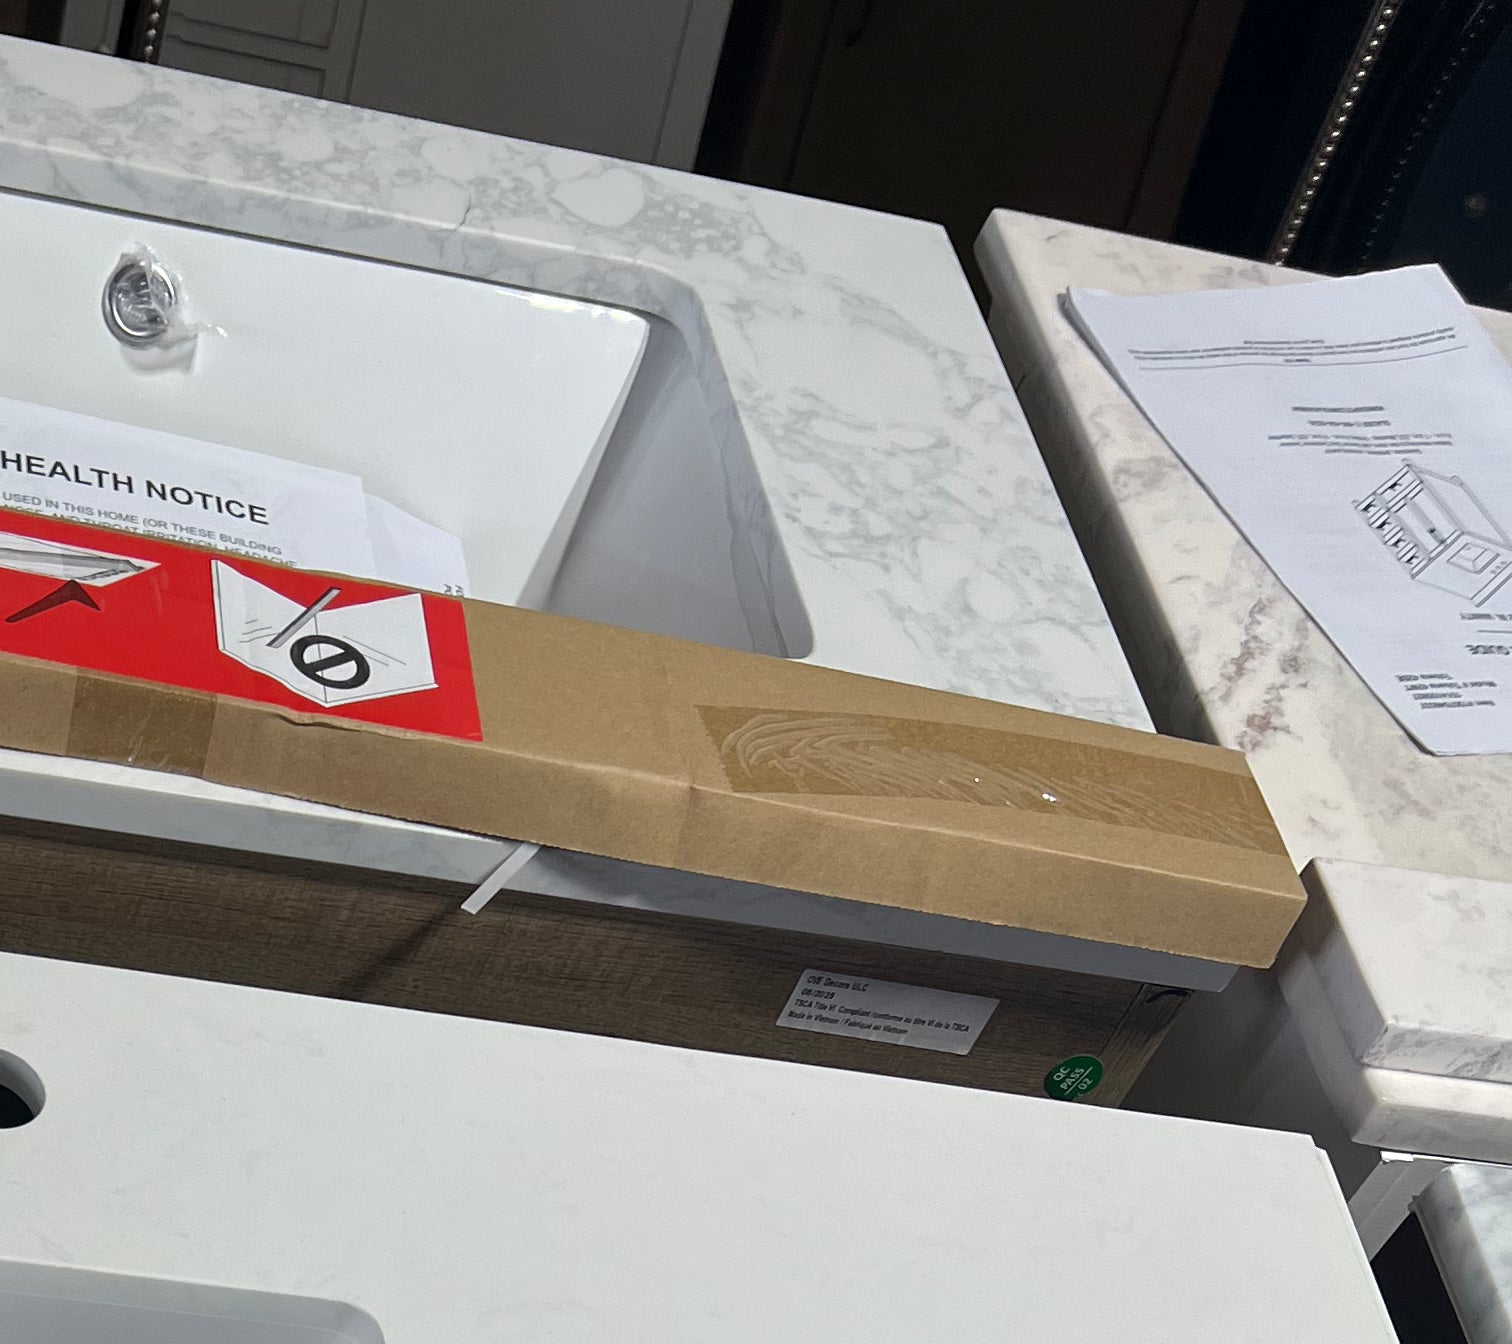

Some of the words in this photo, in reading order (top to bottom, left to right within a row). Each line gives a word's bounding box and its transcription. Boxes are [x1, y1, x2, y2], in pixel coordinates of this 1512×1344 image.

[143, 479, 272, 526] NOTICE
[0, 491, 42, 507] USED
[44, 498, 59, 509] IN
[60, 501, 95, 517] THIS
[96, 508, 140, 525] HOME
[141, 516, 170, 531] (OR
[170, 521, 218, 540] THESE
[218, 531, 284, 556] BUILDING
[1053, 1065, 1071, 1081] QC
[1059, 1067, 1085, 1090] PASS
